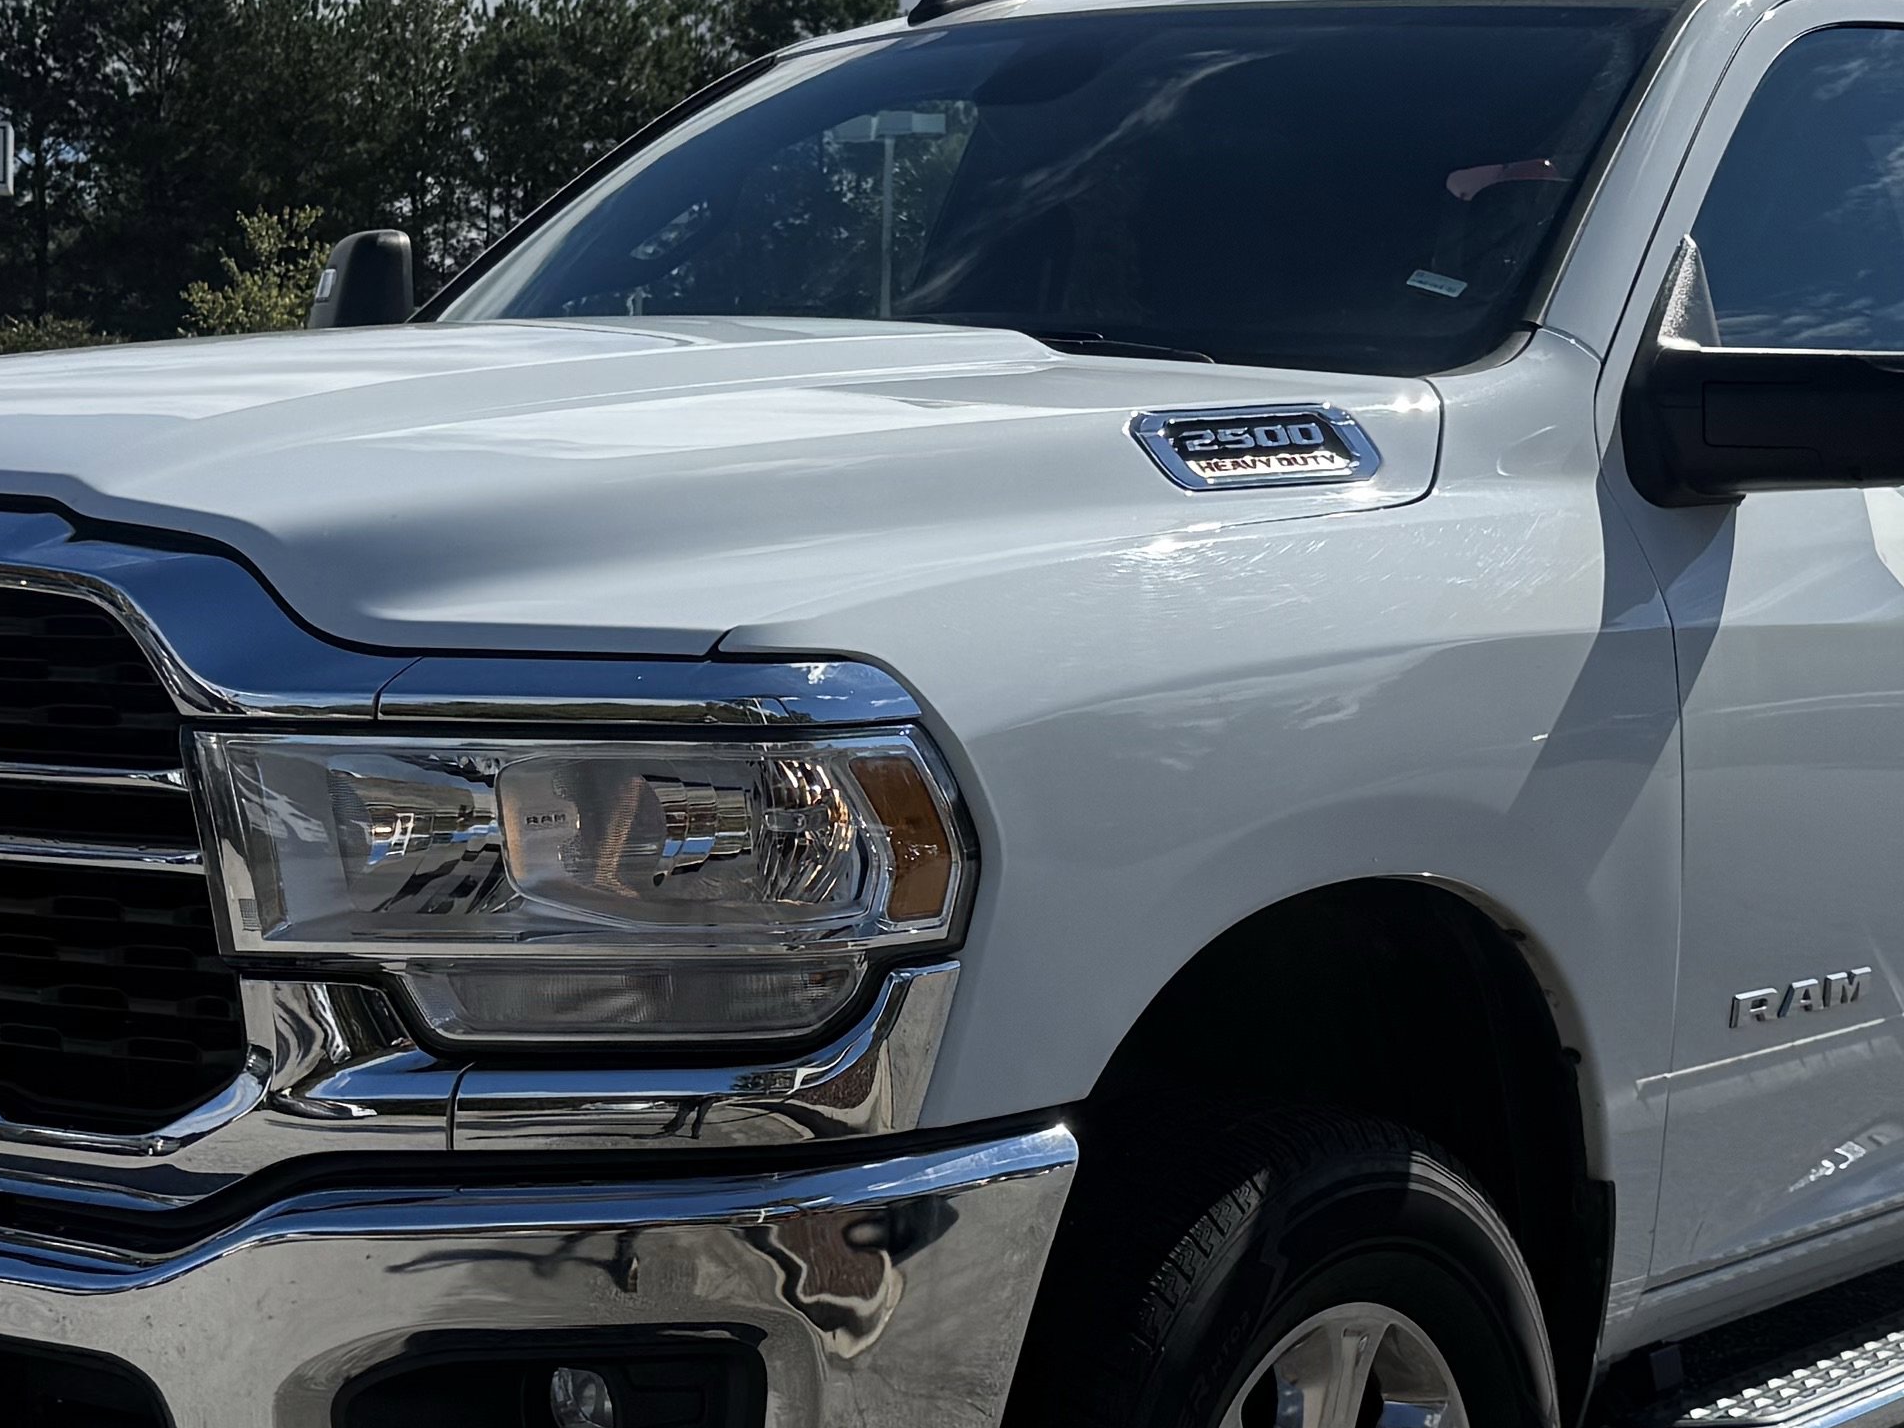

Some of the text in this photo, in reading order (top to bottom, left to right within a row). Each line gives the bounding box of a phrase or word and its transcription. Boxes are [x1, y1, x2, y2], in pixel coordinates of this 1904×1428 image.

[1184, 422, 1326, 452] 2500
[1196, 453, 1338, 474] HEAVY DUTY
[1728, 966, 1872, 1029] RAM
